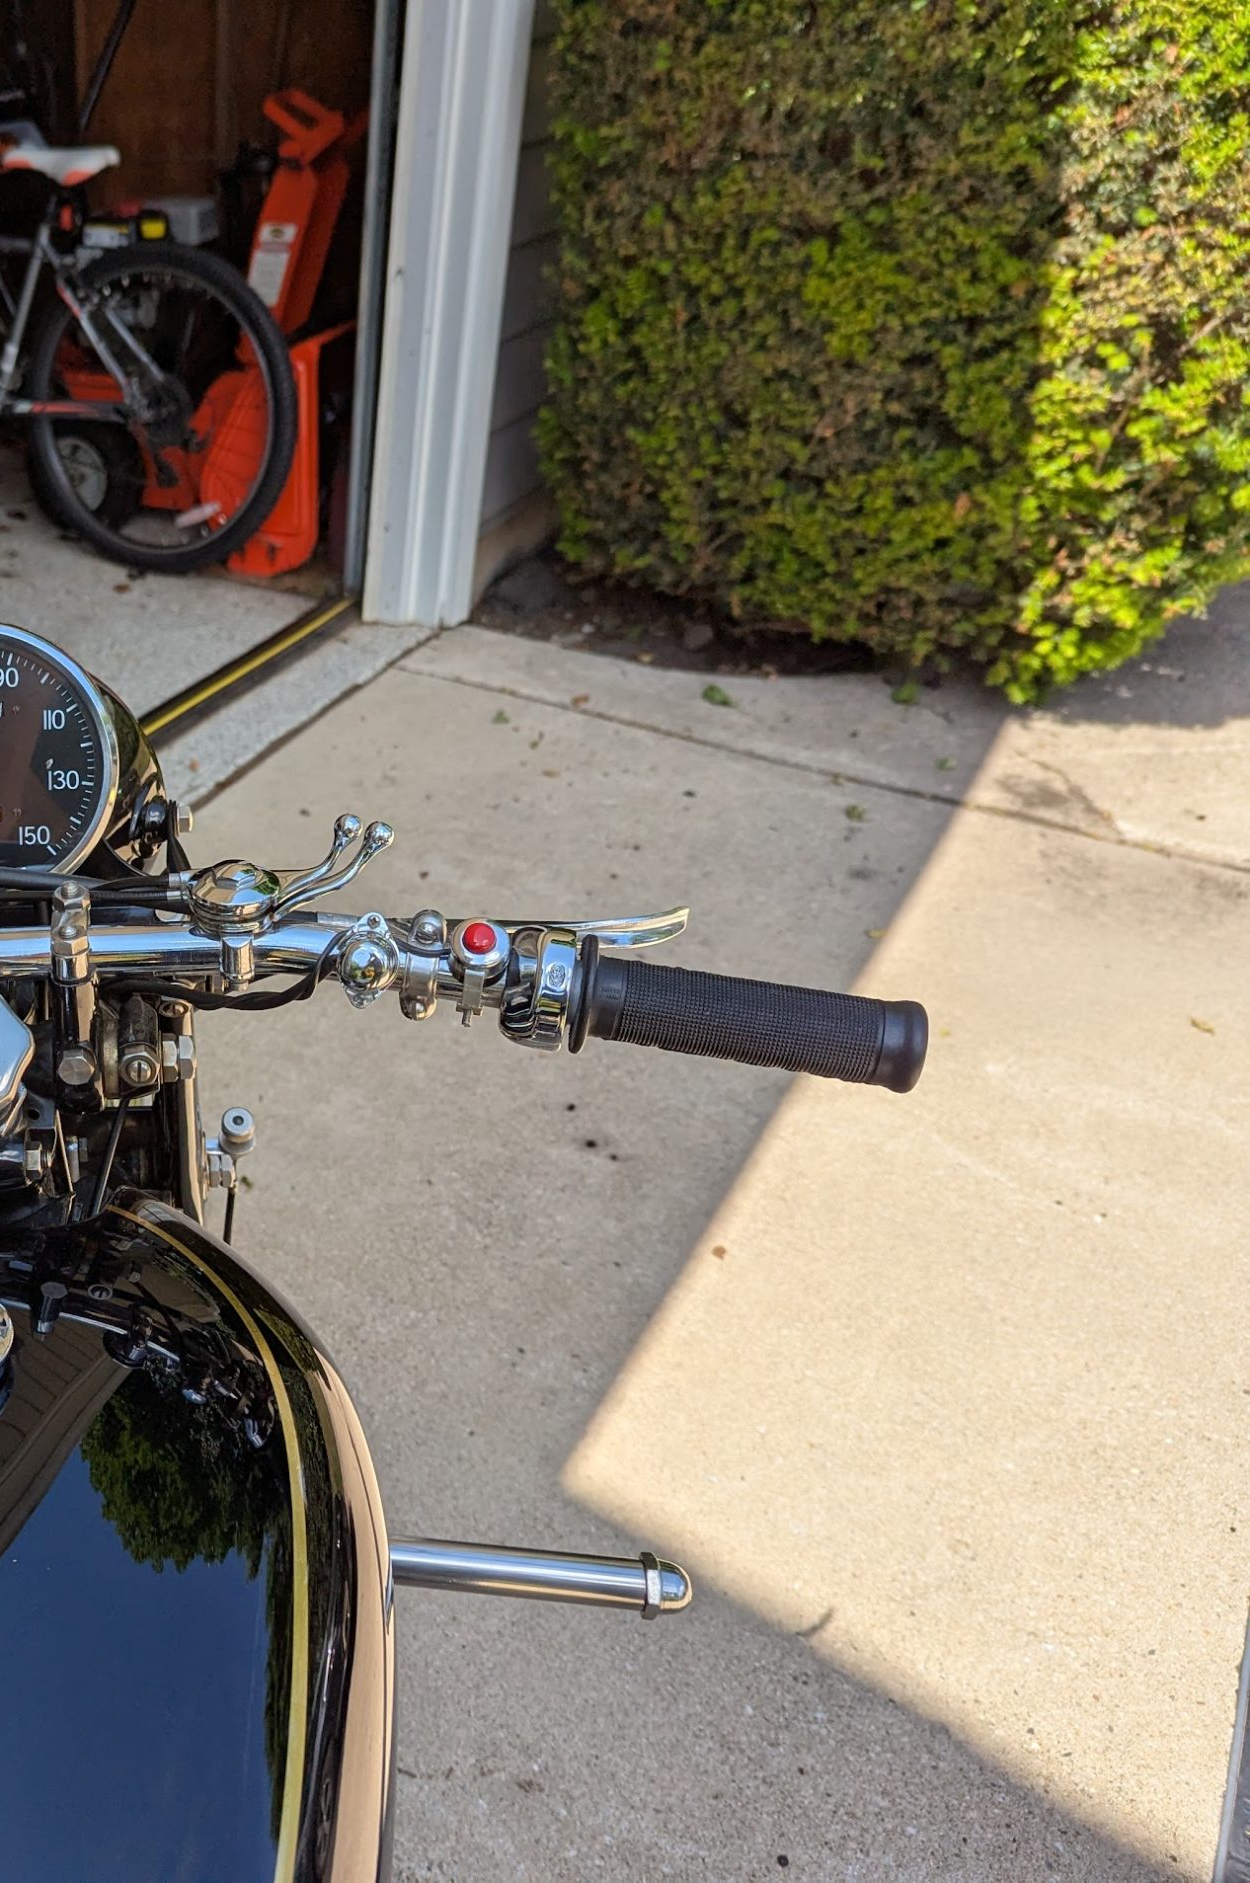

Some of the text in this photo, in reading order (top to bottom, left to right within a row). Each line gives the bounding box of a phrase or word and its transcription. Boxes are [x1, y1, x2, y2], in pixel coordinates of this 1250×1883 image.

[43, 709, 66, 731] 110
[47, 770, 80, 791] 130
[18, 825, 50, 846] 150
